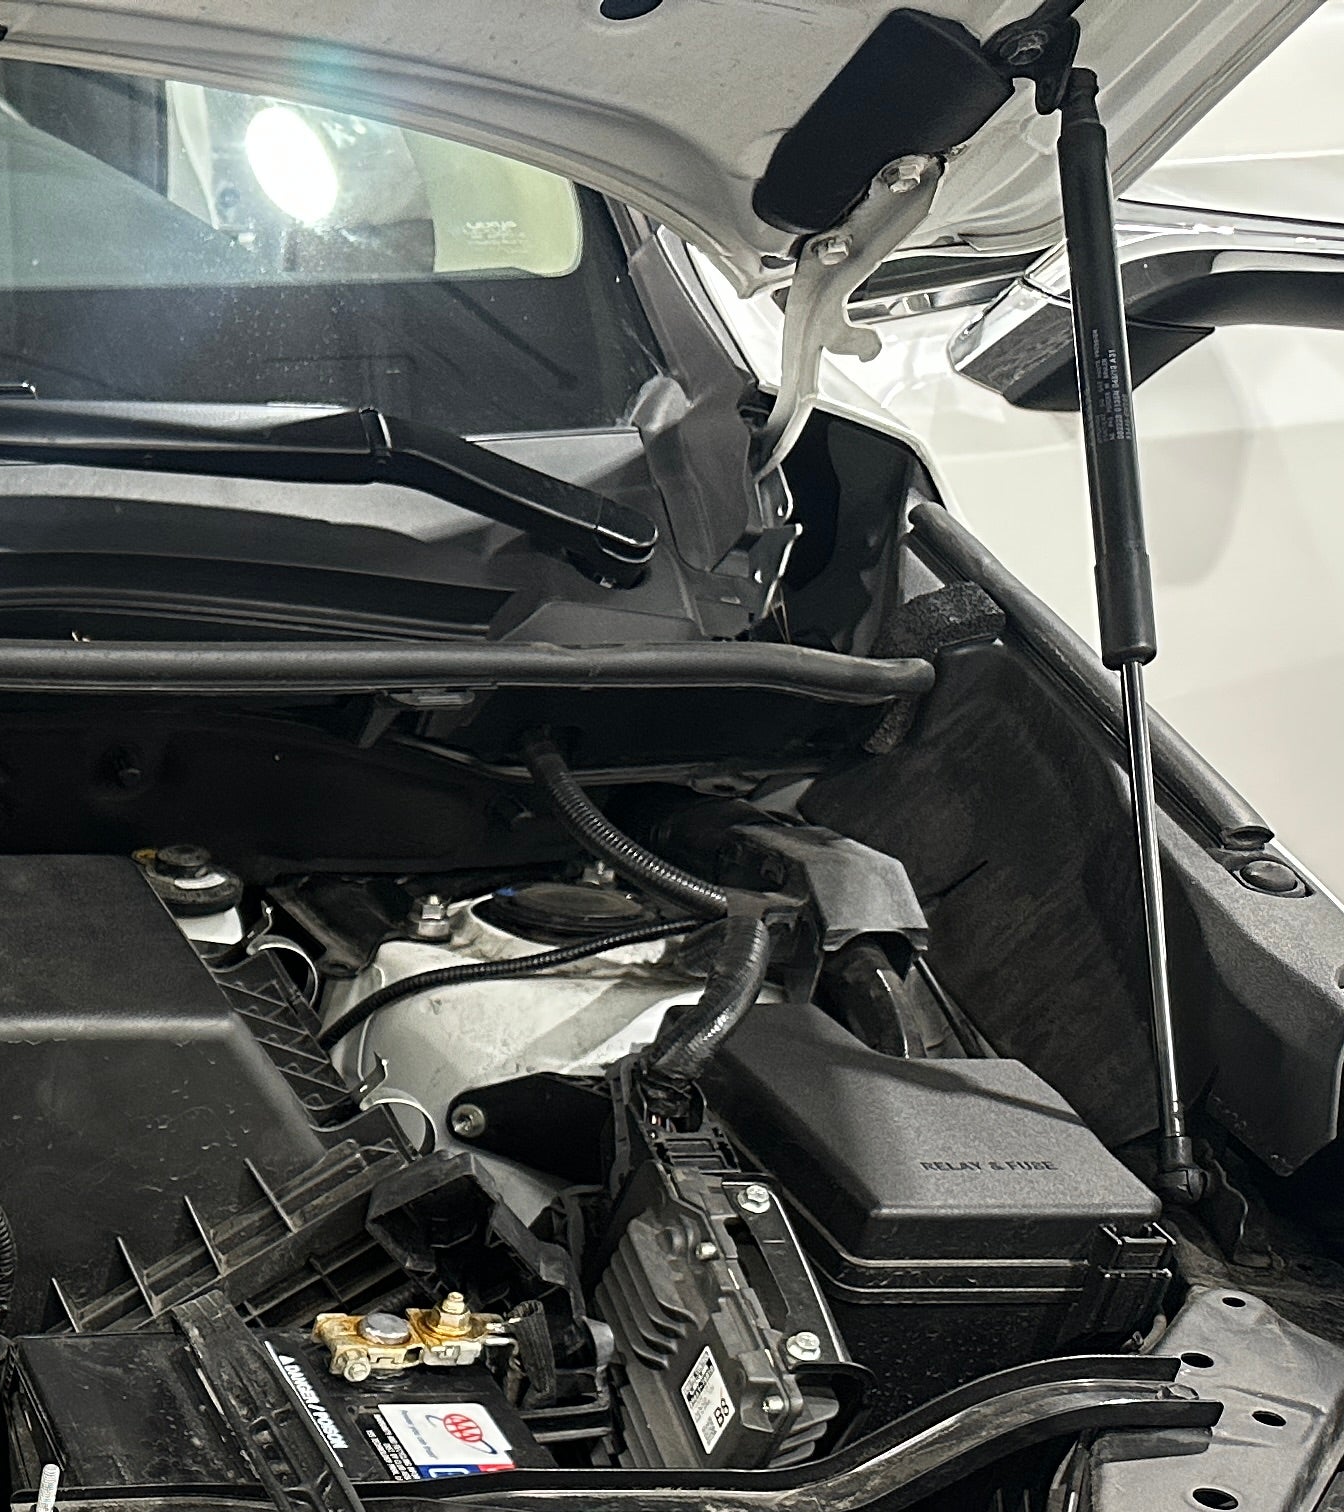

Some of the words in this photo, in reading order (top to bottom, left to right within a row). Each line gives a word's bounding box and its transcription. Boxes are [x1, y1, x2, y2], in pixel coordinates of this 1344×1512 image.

[920, 1161, 981, 1171] RELAY
[1005, 1160, 1059, 1171] FUSE
[283, 1364, 320, 1404] DANGER
[312, 1411, 349, 1449] POISON
